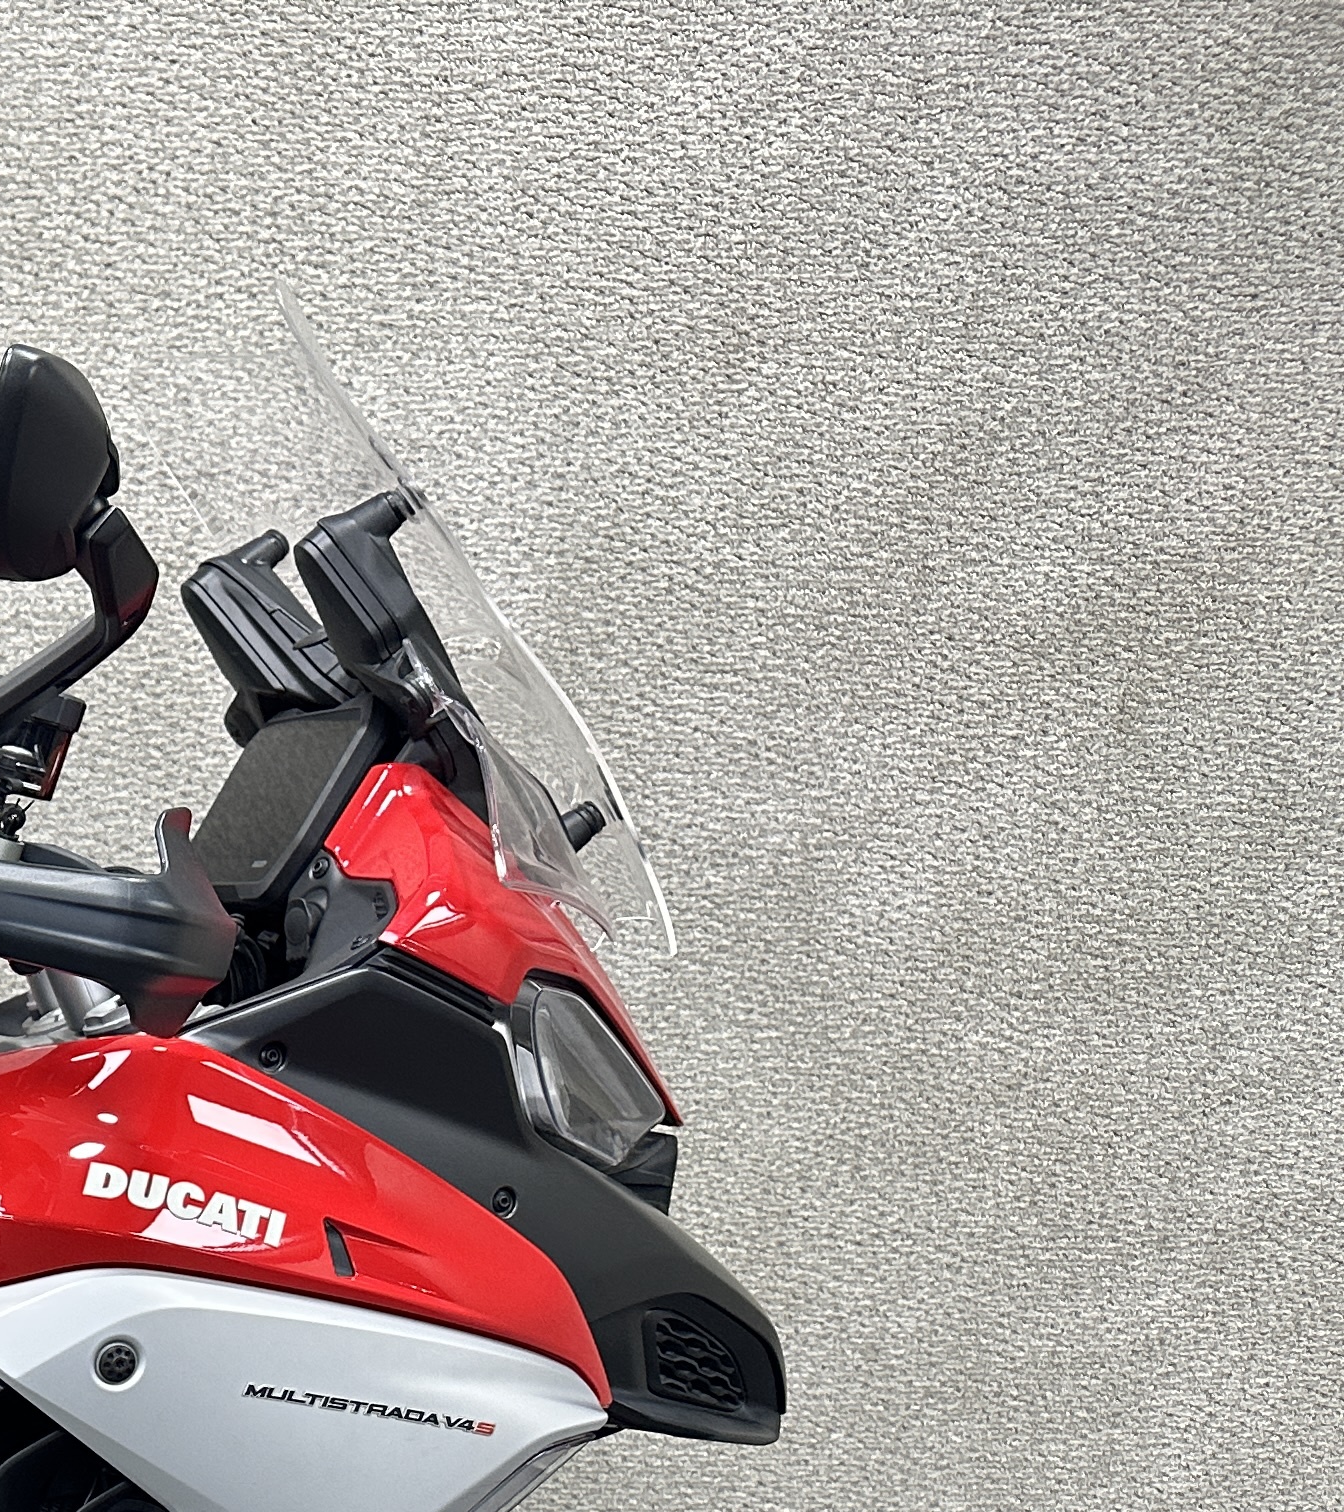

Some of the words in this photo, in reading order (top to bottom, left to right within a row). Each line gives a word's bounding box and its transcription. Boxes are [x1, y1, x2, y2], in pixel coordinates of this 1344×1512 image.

[82, 1161, 287, 1248] DUCATI
[243, 1383, 440, 1427] MULTISTRADA
[444, 1415, 496, 1437] V4S
